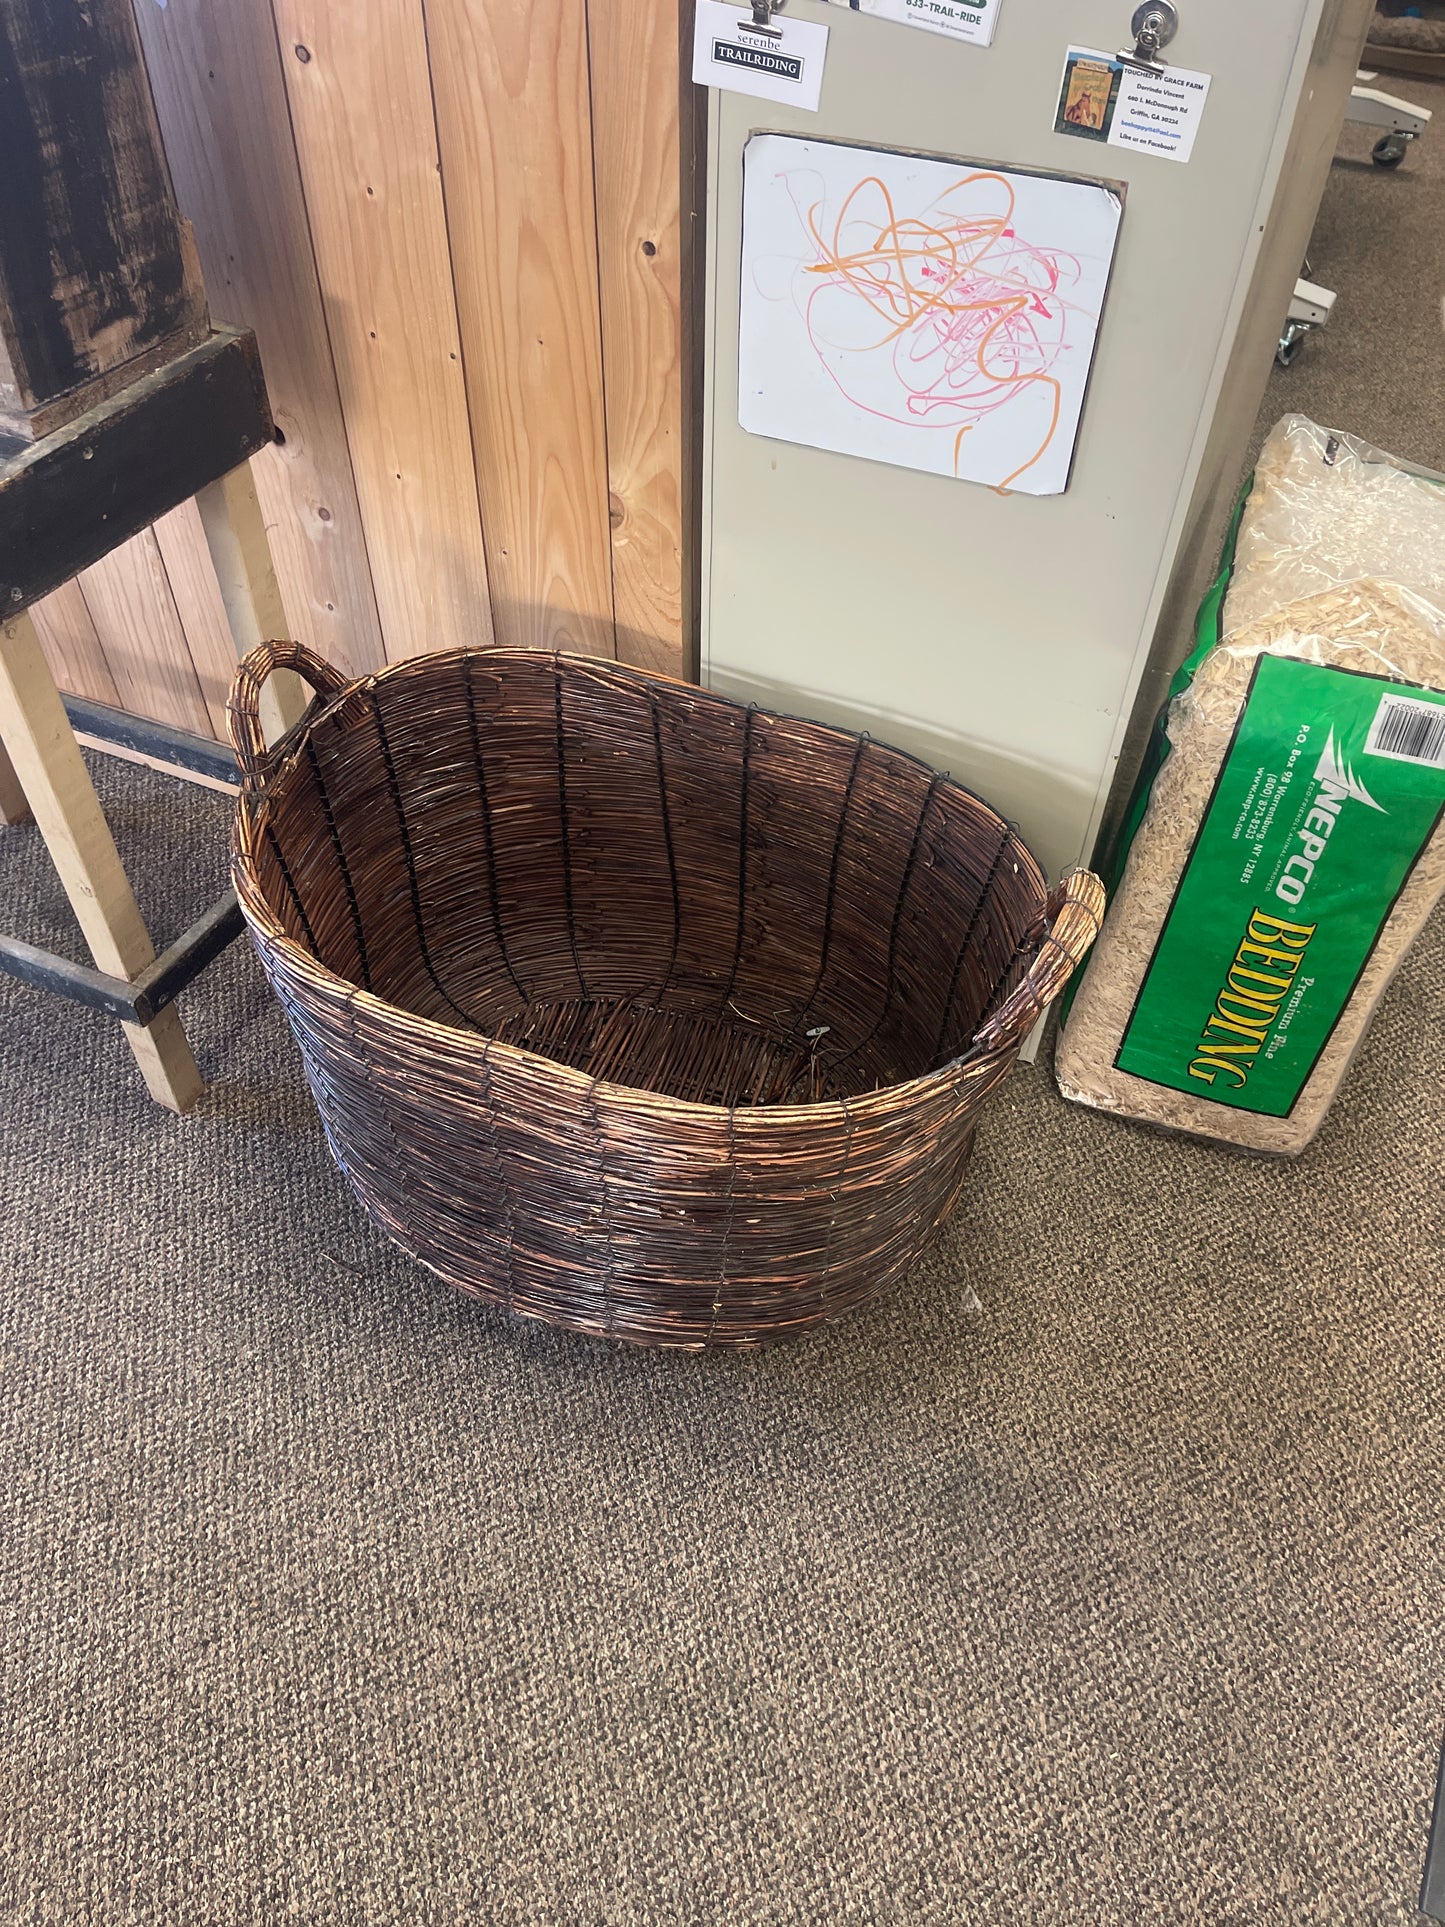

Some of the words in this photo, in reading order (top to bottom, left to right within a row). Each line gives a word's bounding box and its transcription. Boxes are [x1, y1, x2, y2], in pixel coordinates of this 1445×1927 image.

[737, 33, 781, 51] serenbe
[717, 46, 797, 75] TRAILRIDING
[1124, 68, 1153, 79] TOUCHED
[1154, 73, 1163, 81] BY
[1164, 75, 1185, 86] GRACE
[1185, 82, 1204, 91] FARM
[1145, 98, 1178, 111] McDonough
[1179, 106, 1188, 114] Rd
[1163, 90, 1184, 100] Vincent
[1130, 108, 1150, 119] Griffin,
[1151, 113, 1160, 121] GA
[1119, 132, 1131, 141] Like
[1147, 140, 1177, 152] Facebook!
[1294, 724, 1311, 746] P.O.
[1286, 749, 1302, 768] Box
[1259, 773, 1278, 799] (800)
[1281, 771, 1293, 784] 98
[1231, 767, 1265, 840] www.nep-co.com
[1255, 786, 1288, 841] Warrensburg,
[1244, 800, 1268, 840] 873-8233
[1251, 843, 1264, 858] NY
[1275, 778, 1350, 905] NEPCO
[1240, 858, 1258, 884] 12885
[1187, 906, 1318, 1089] BEDDING
[1278, 976, 1315, 1031] Premium
